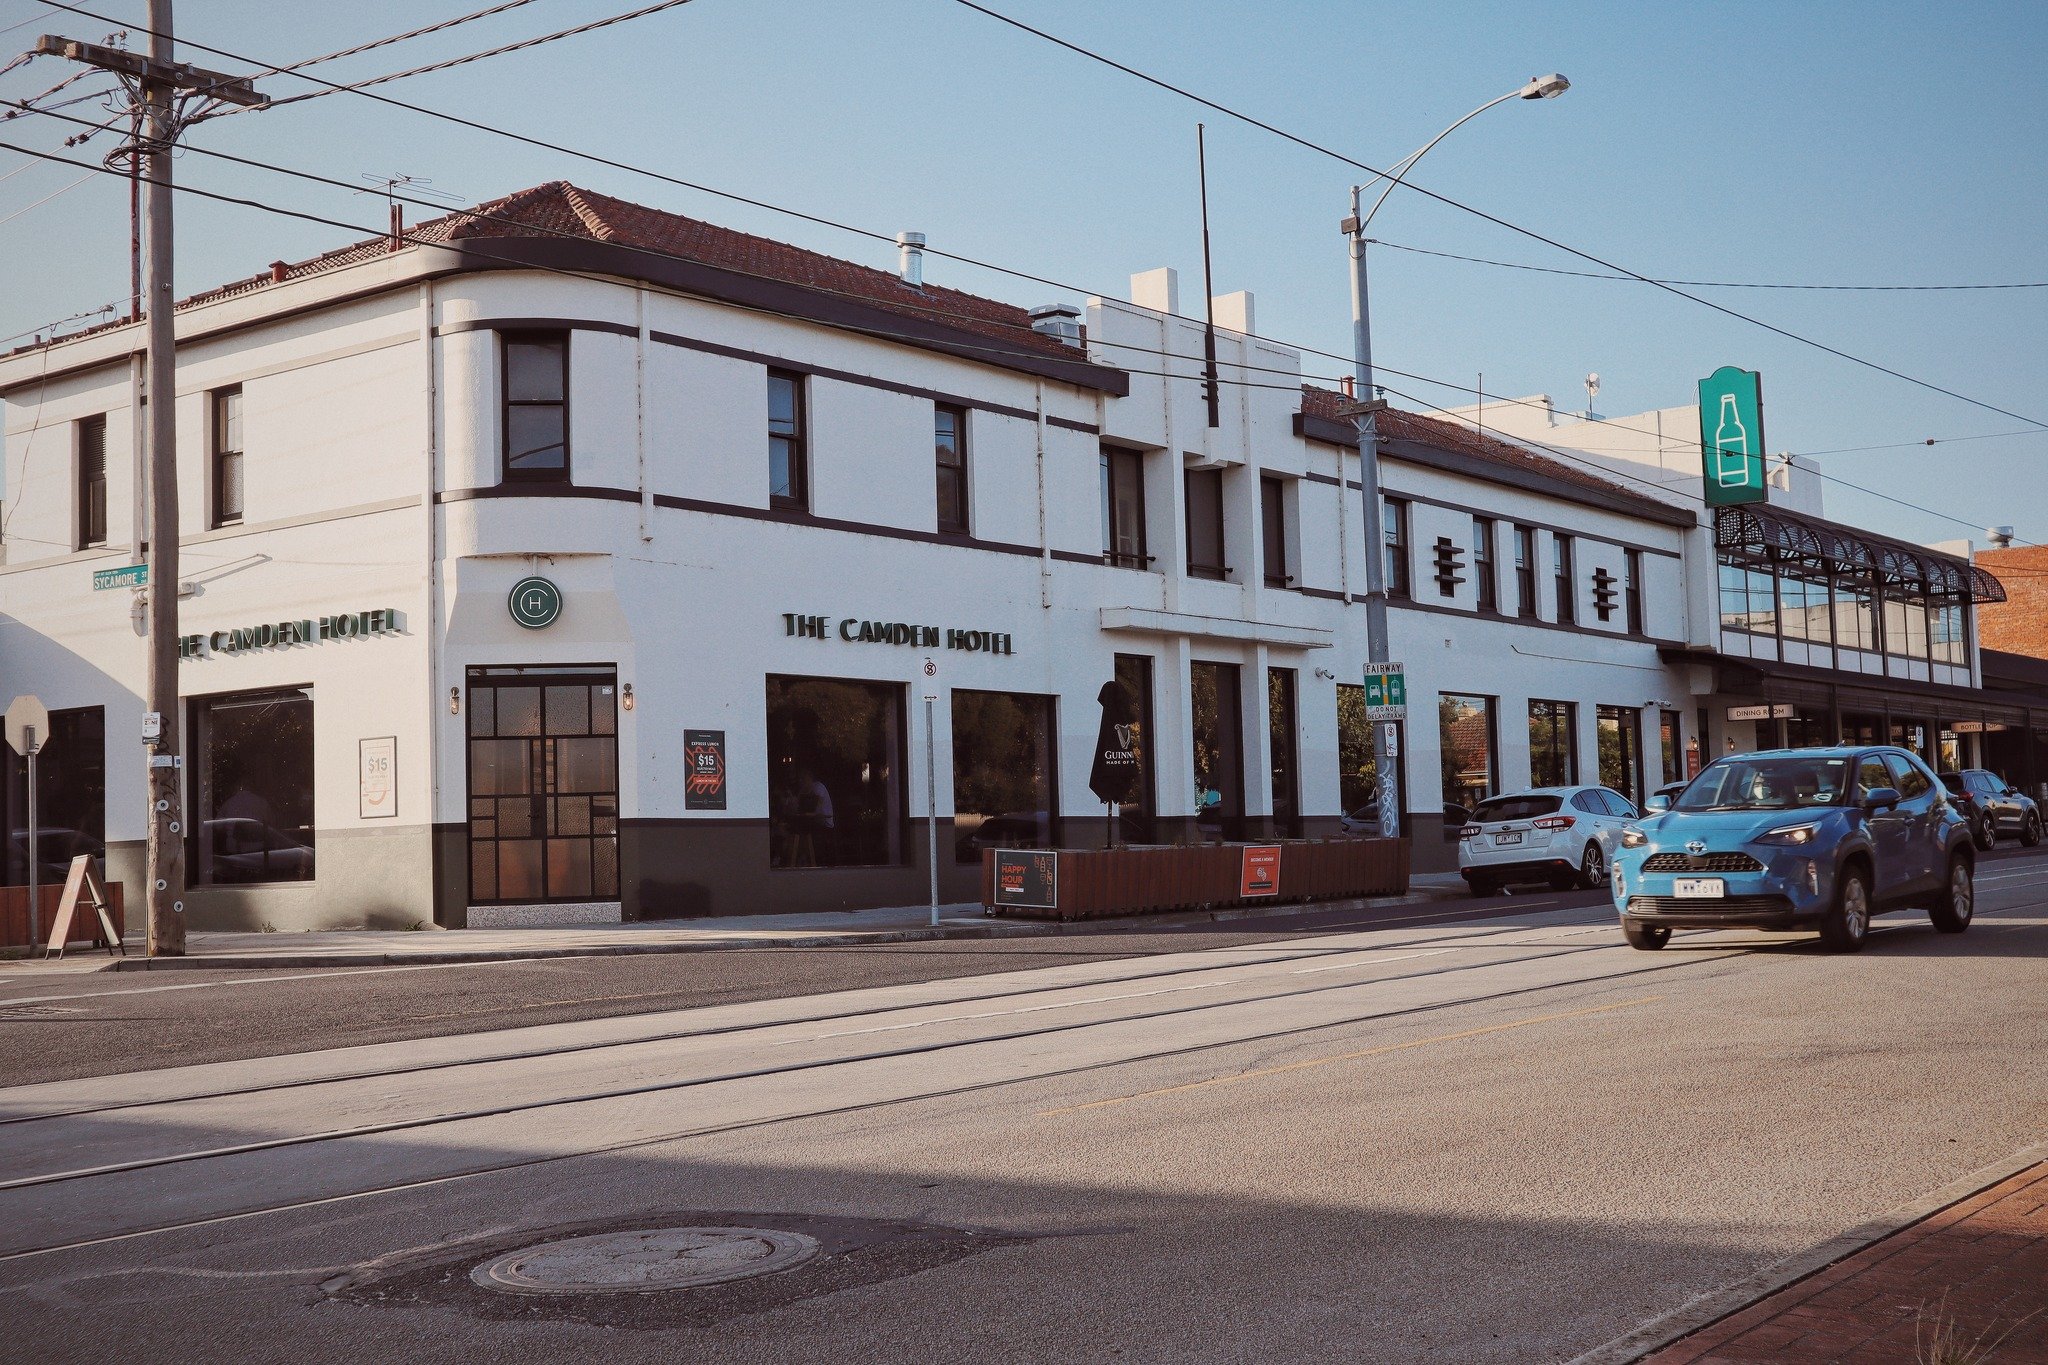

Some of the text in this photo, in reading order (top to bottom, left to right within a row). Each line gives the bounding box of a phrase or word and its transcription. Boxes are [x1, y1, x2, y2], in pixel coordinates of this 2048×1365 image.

[94, 572, 138, 590] SYCAMORE
[209, 621, 311, 652] CAMDEN
[319, 607, 401, 639] HOTEL
[782, 613, 1018, 656] THE CAMDEN HOTEL
[1366, 663, 1401, 674] FAIRWAY
[1736, 708, 1785, 717] DINING ROM
[367, 756, 388, 774] $15
[698, 753, 715, 767] $15
[1001, 865, 1027, 874] HAPPY
[1001, 875, 1024, 884] HOUR
